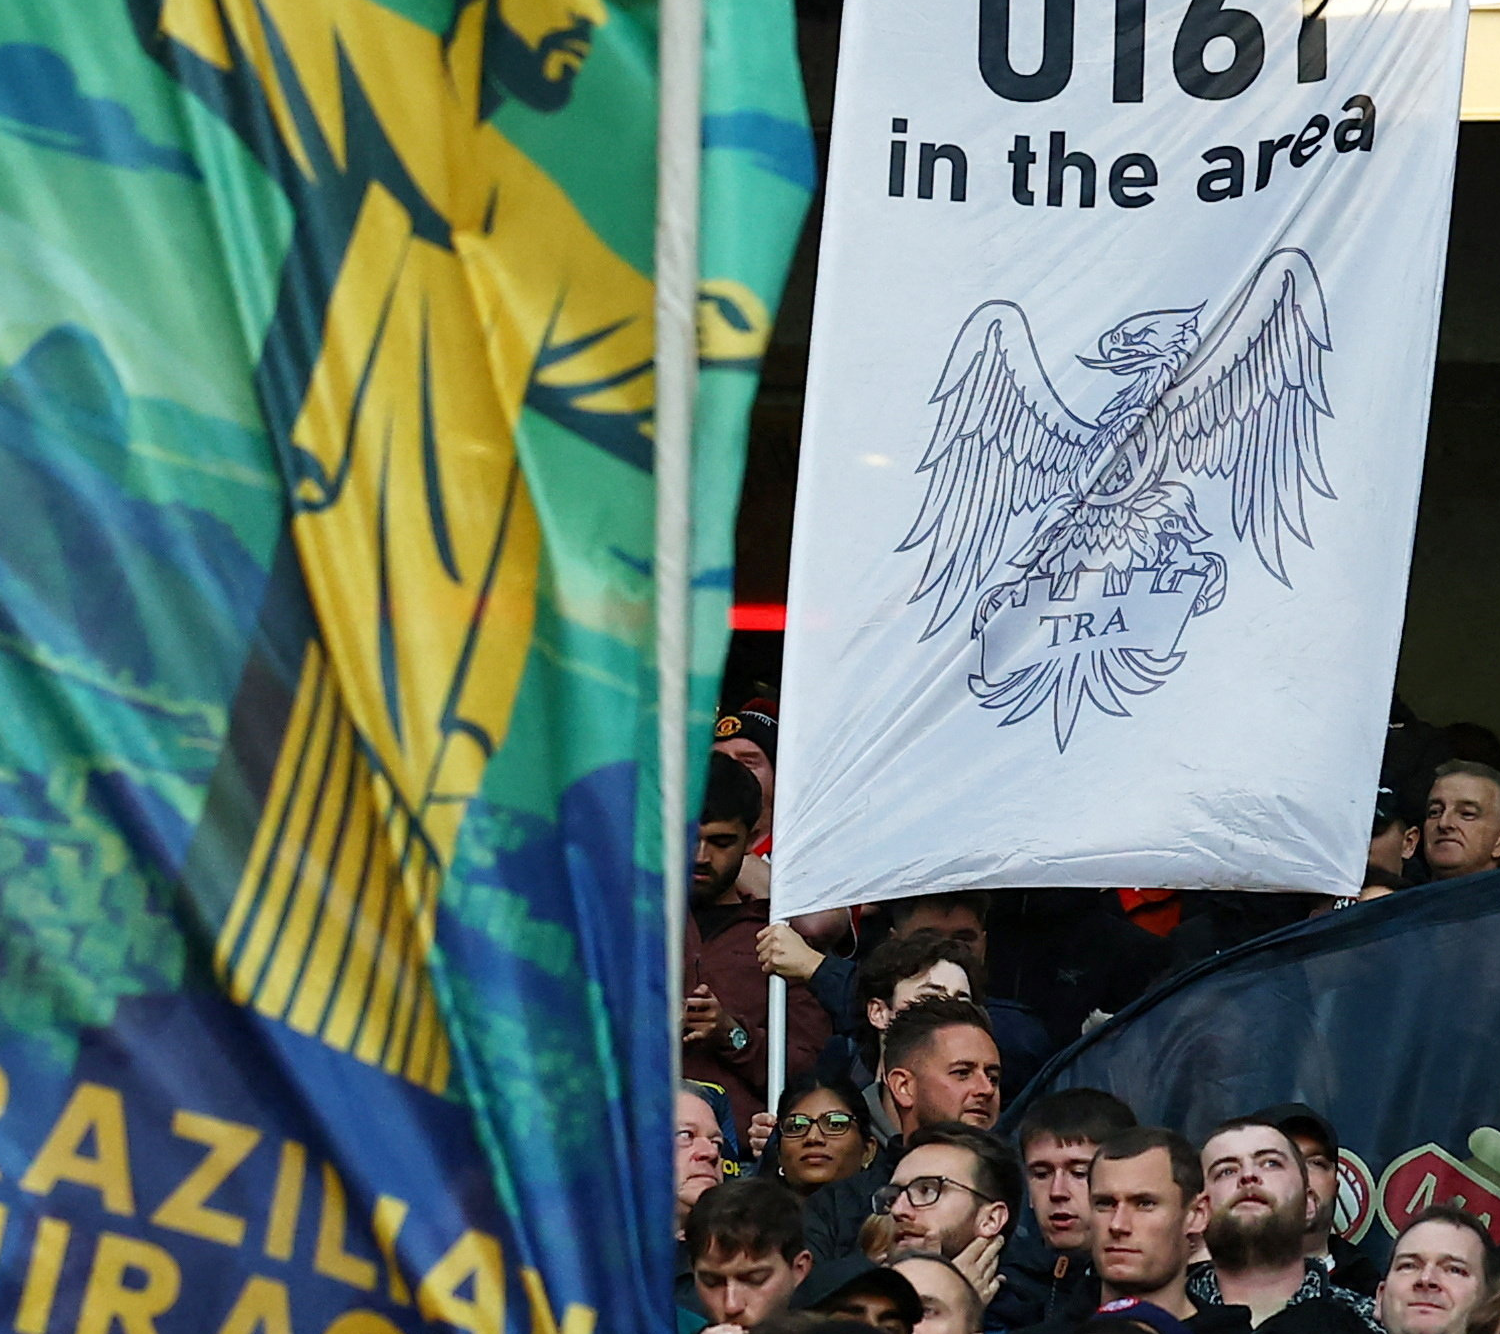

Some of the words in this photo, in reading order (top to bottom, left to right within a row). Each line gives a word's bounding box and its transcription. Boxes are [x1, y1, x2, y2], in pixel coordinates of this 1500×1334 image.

[887, 118, 969, 204] in
[1006, 131, 1159, 209] the
[1197, 92, 1375, 207] area
[1039, 606, 1130, 648] TRA
